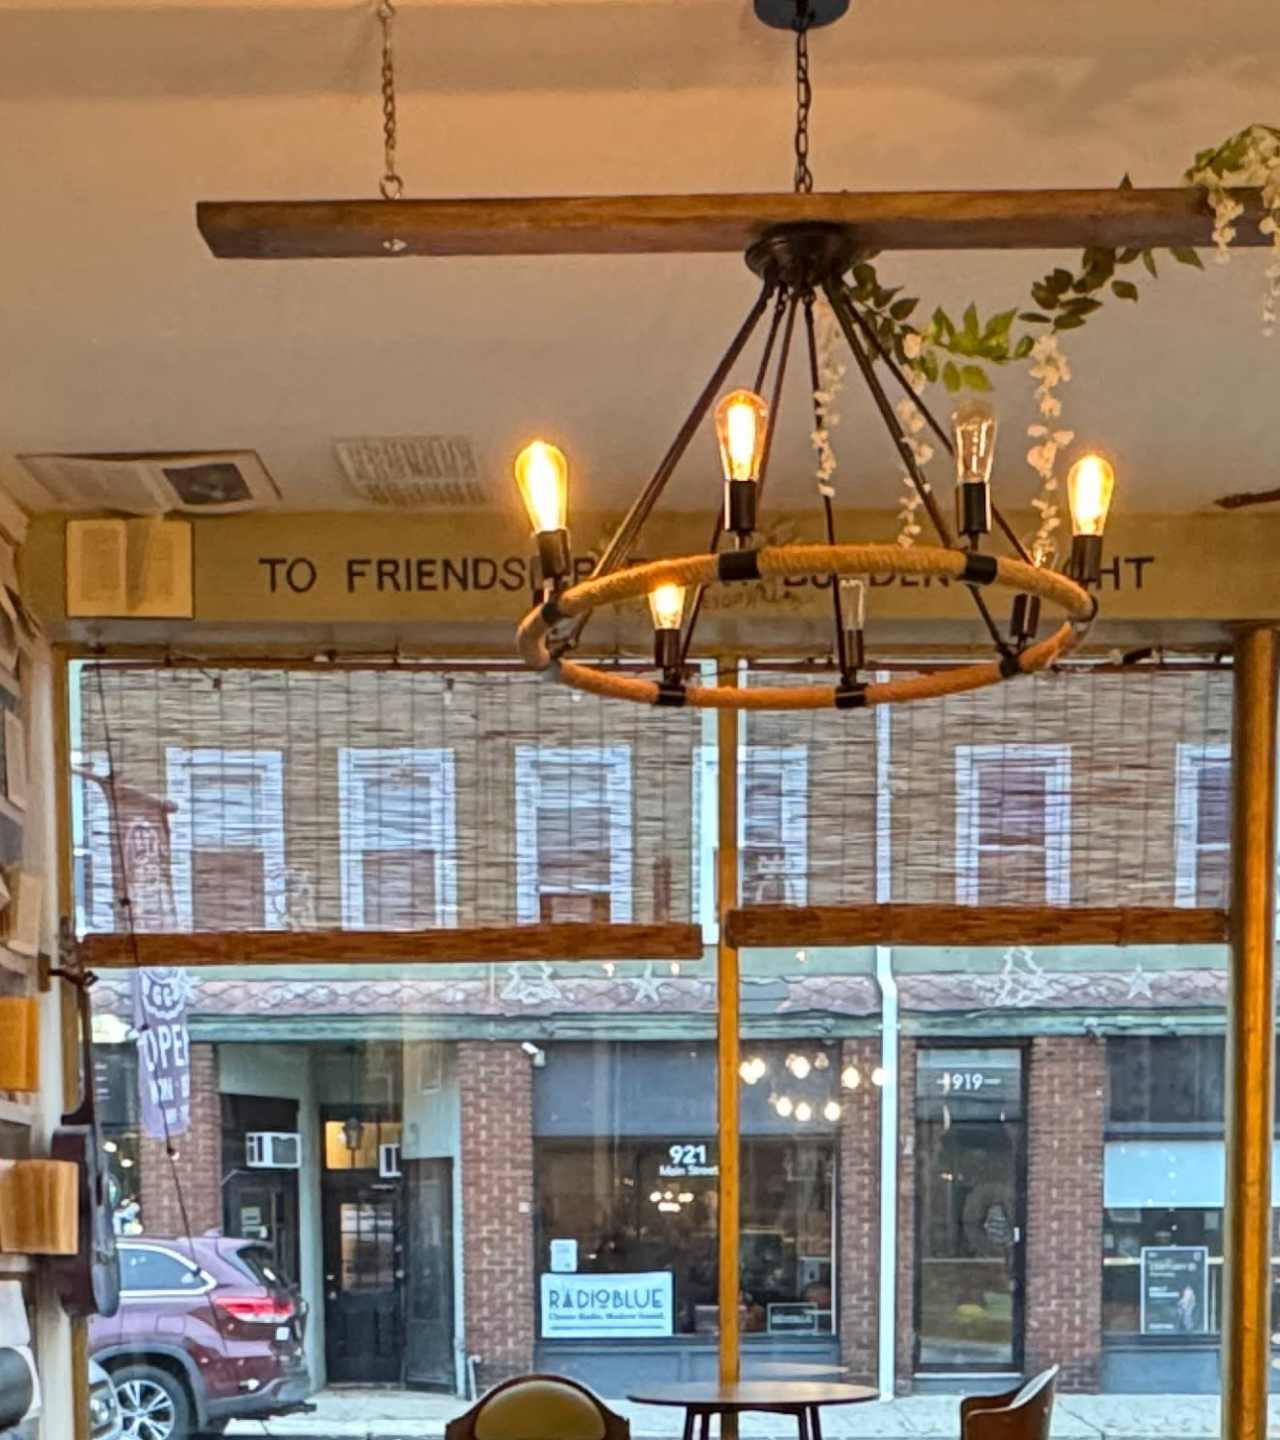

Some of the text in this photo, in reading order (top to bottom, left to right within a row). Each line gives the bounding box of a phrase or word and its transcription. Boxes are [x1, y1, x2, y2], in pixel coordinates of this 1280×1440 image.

[258, 557, 317, 593] TO
[346, 556, 598, 593] FRIENDSP
[951, 1072, 984, 1091] 919
[669, 1145, 707, 1165] 921
[549, 1287, 664, 1310] RADIOBLUE
